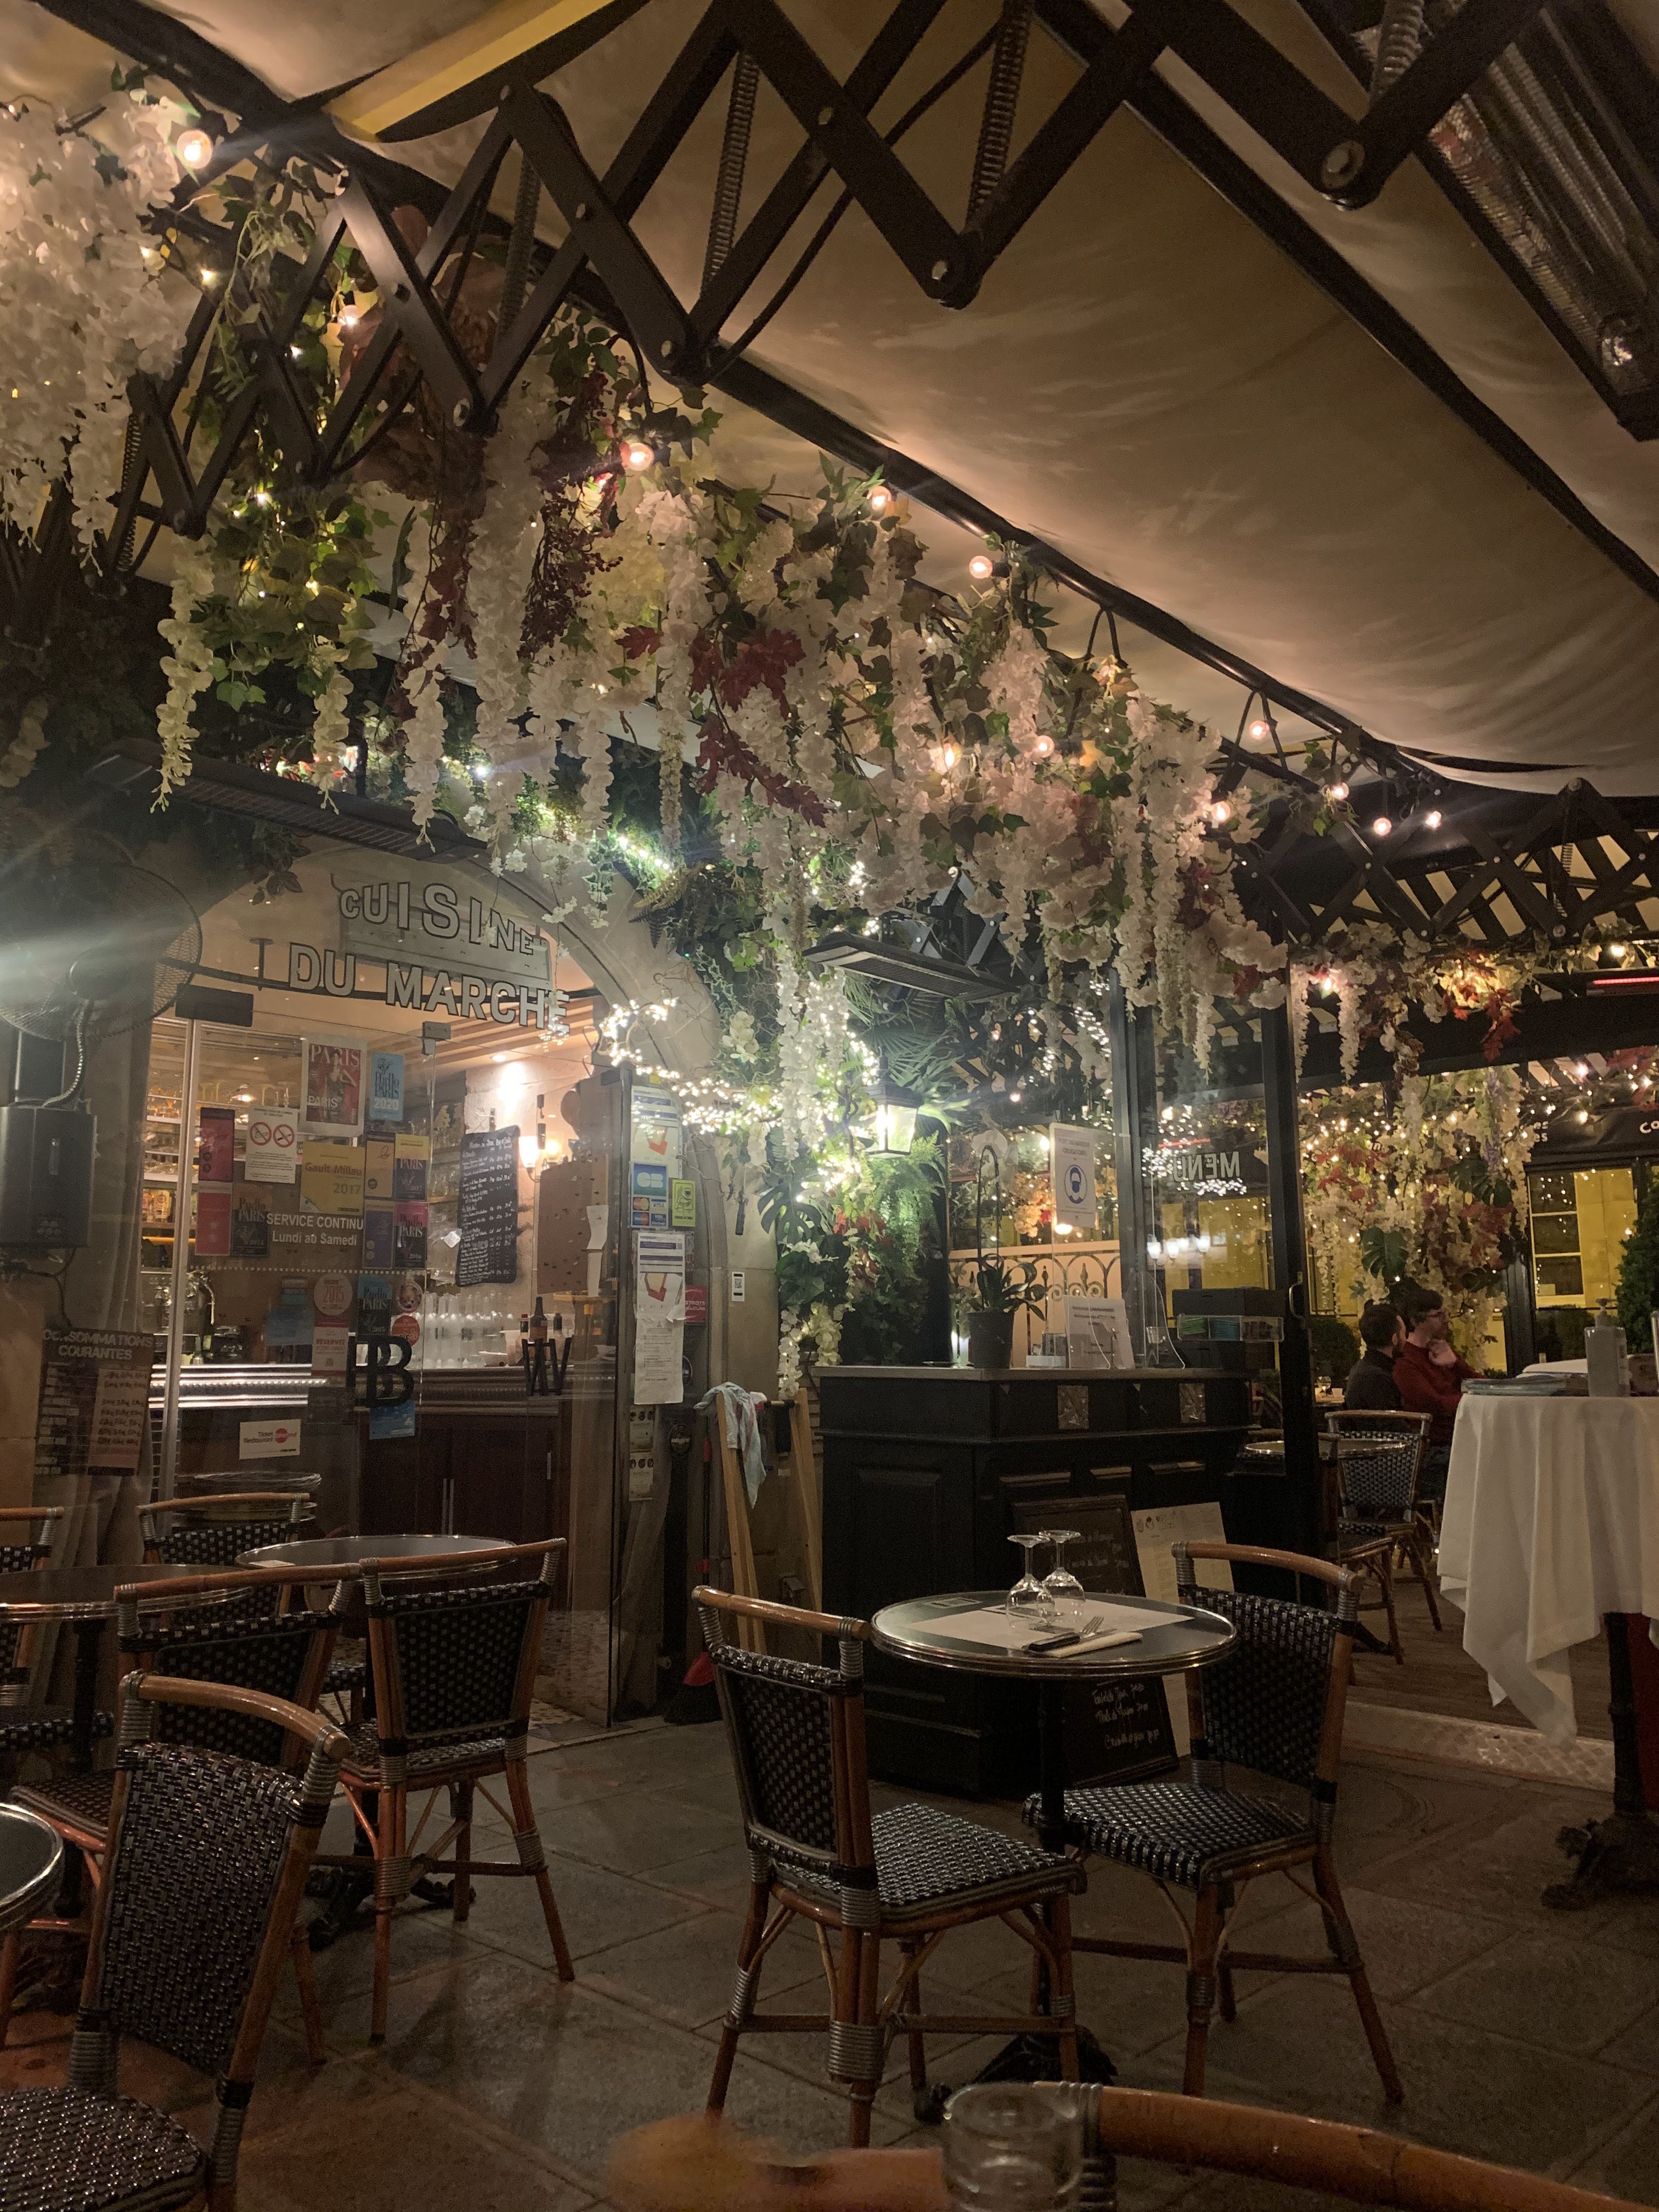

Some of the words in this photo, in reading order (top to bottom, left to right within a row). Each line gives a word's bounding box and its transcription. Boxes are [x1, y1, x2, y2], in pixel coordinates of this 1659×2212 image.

[339, 882, 534, 956] CUISINE
[289, 941, 356, 997] DU
[311, 1045, 359, 1067] PARIS
[375, 1084, 399, 1099] PARIS
[308, 1096, 338, 1108] PARIS
[374, 1098, 399, 1111] 2020
[333, 1183, 362, 1194] 2017
[267, 1212, 314, 1228] SERVICE
[317, 1216, 364, 1231] CONTINU
[272, 1231, 302, 1244] Lundi
[304, 1234, 317, 1245] au
[320, 1233, 357, 1246] Samedi
[399, 1226, 423, 1238] PARIS
[363, 1298, 387, 1310] PARIS
[58, 1345, 133, 1361] COURANTES
